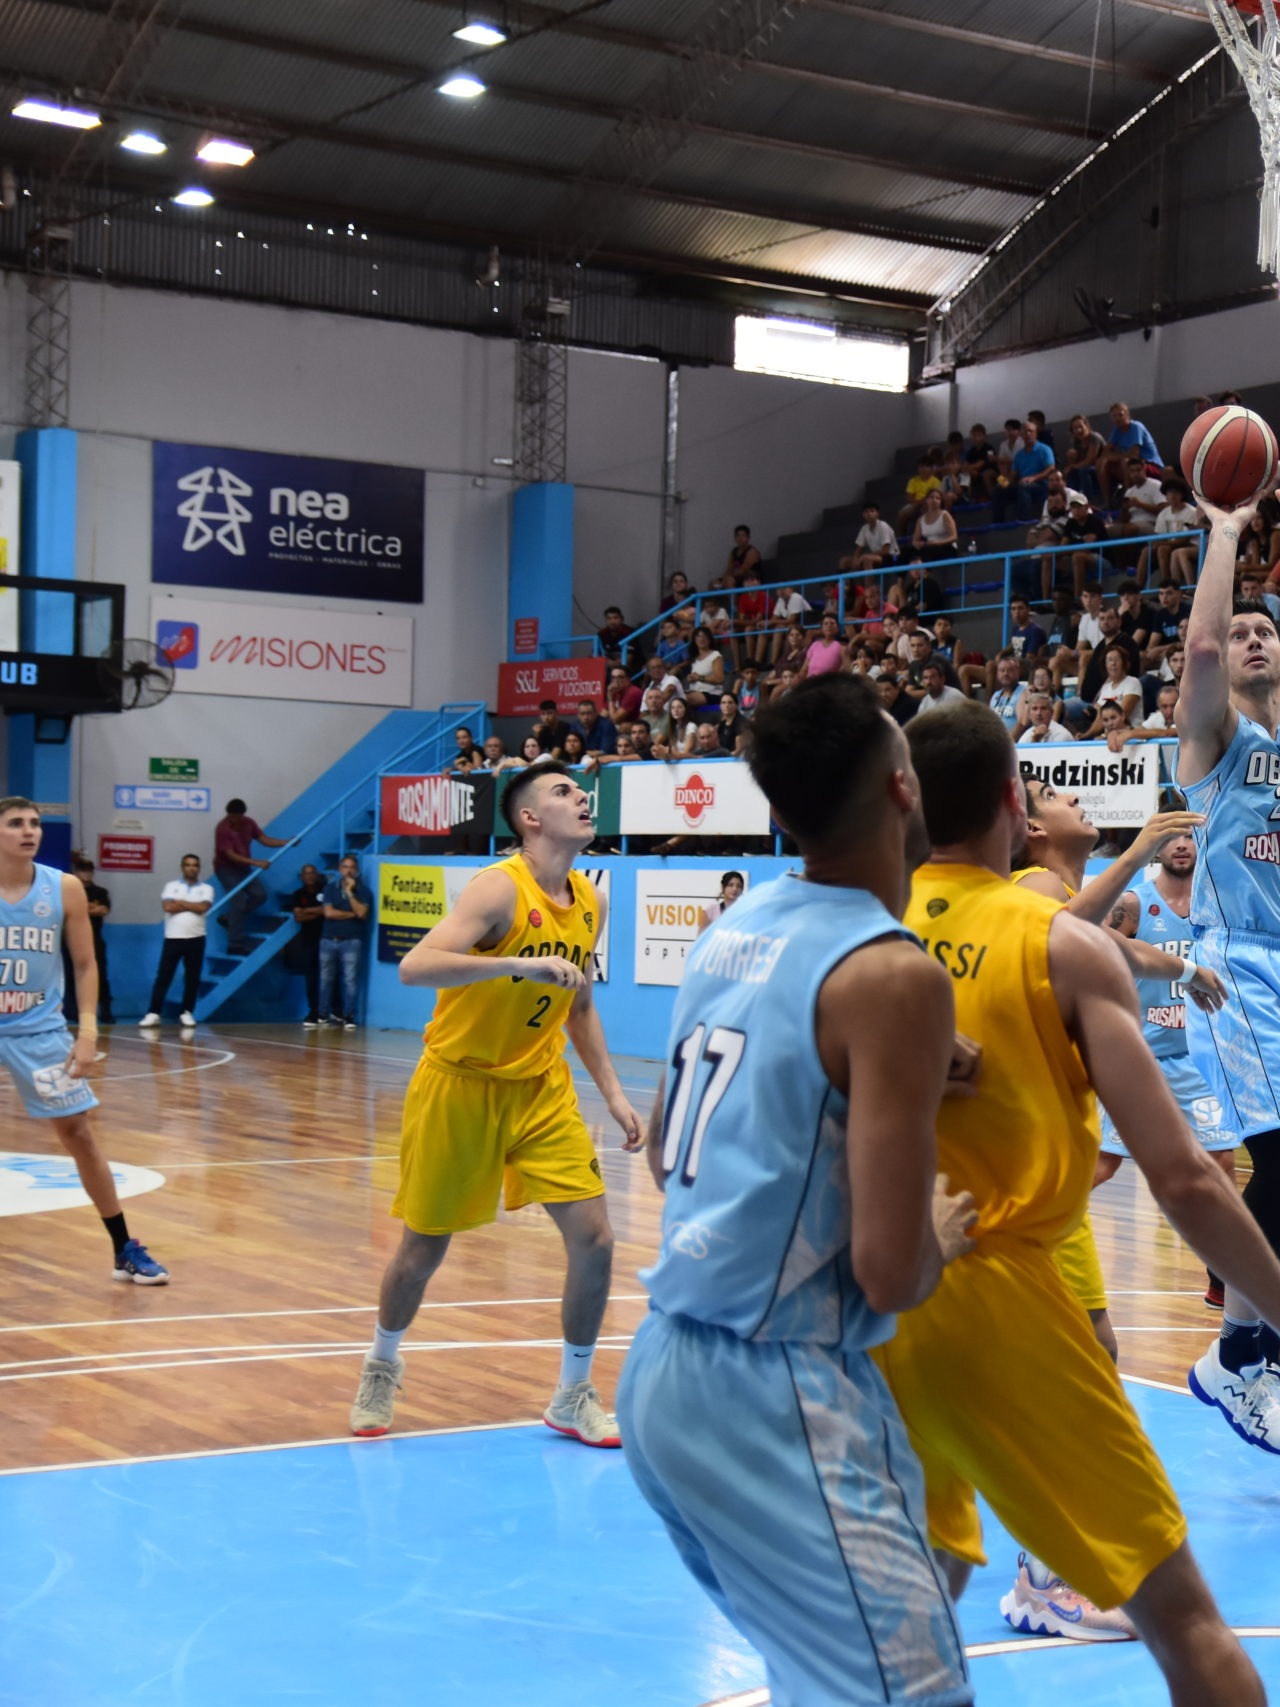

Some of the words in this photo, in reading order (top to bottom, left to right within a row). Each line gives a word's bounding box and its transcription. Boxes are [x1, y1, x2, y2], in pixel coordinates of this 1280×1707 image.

[269, 487, 349, 521] nea
[268, 521, 402, 557] eléctrica
[209, 635, 387, 675] MISIONES
[398, 778, 476, 831] ROSAMONTE
[675, 789, 713, 805] DINCO
[391, 875, 434, 895] Fontana
[381, 895, 444, 916] Neumáticos
[922, 938, 988, 980] SSI
[526, 995, 552, 1029] 2
[662, 1022, 747, 1188] 17
